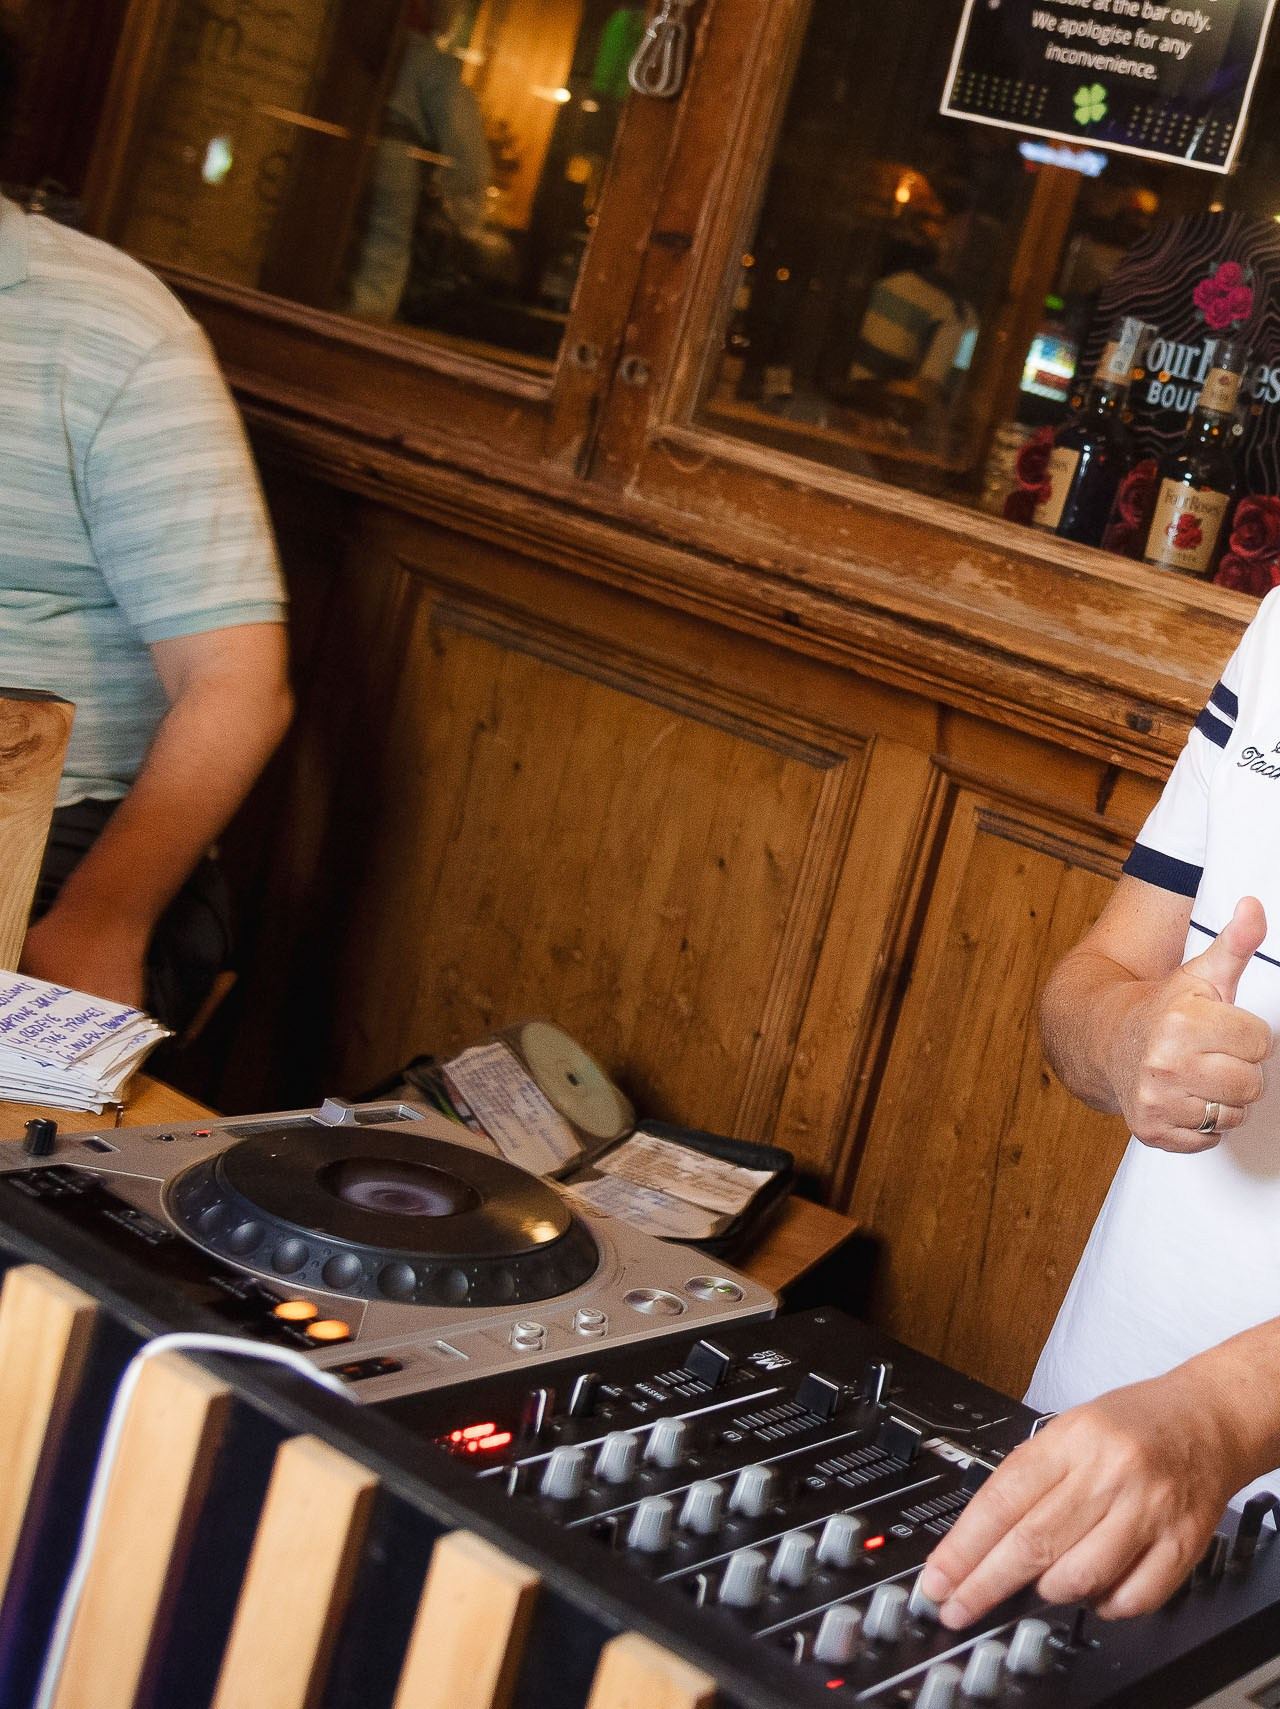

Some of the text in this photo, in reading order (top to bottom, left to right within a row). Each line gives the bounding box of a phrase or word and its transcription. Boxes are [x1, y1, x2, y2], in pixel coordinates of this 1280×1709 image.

[1032, 9, 1192, 60] We apologise for any
[1113, 0, 1140, 17] the
[1141, 1, 1170, 21] bar
[1170, 8, 1211, 33] only.
[1044, 41, 1157, 80] inconvenience.
